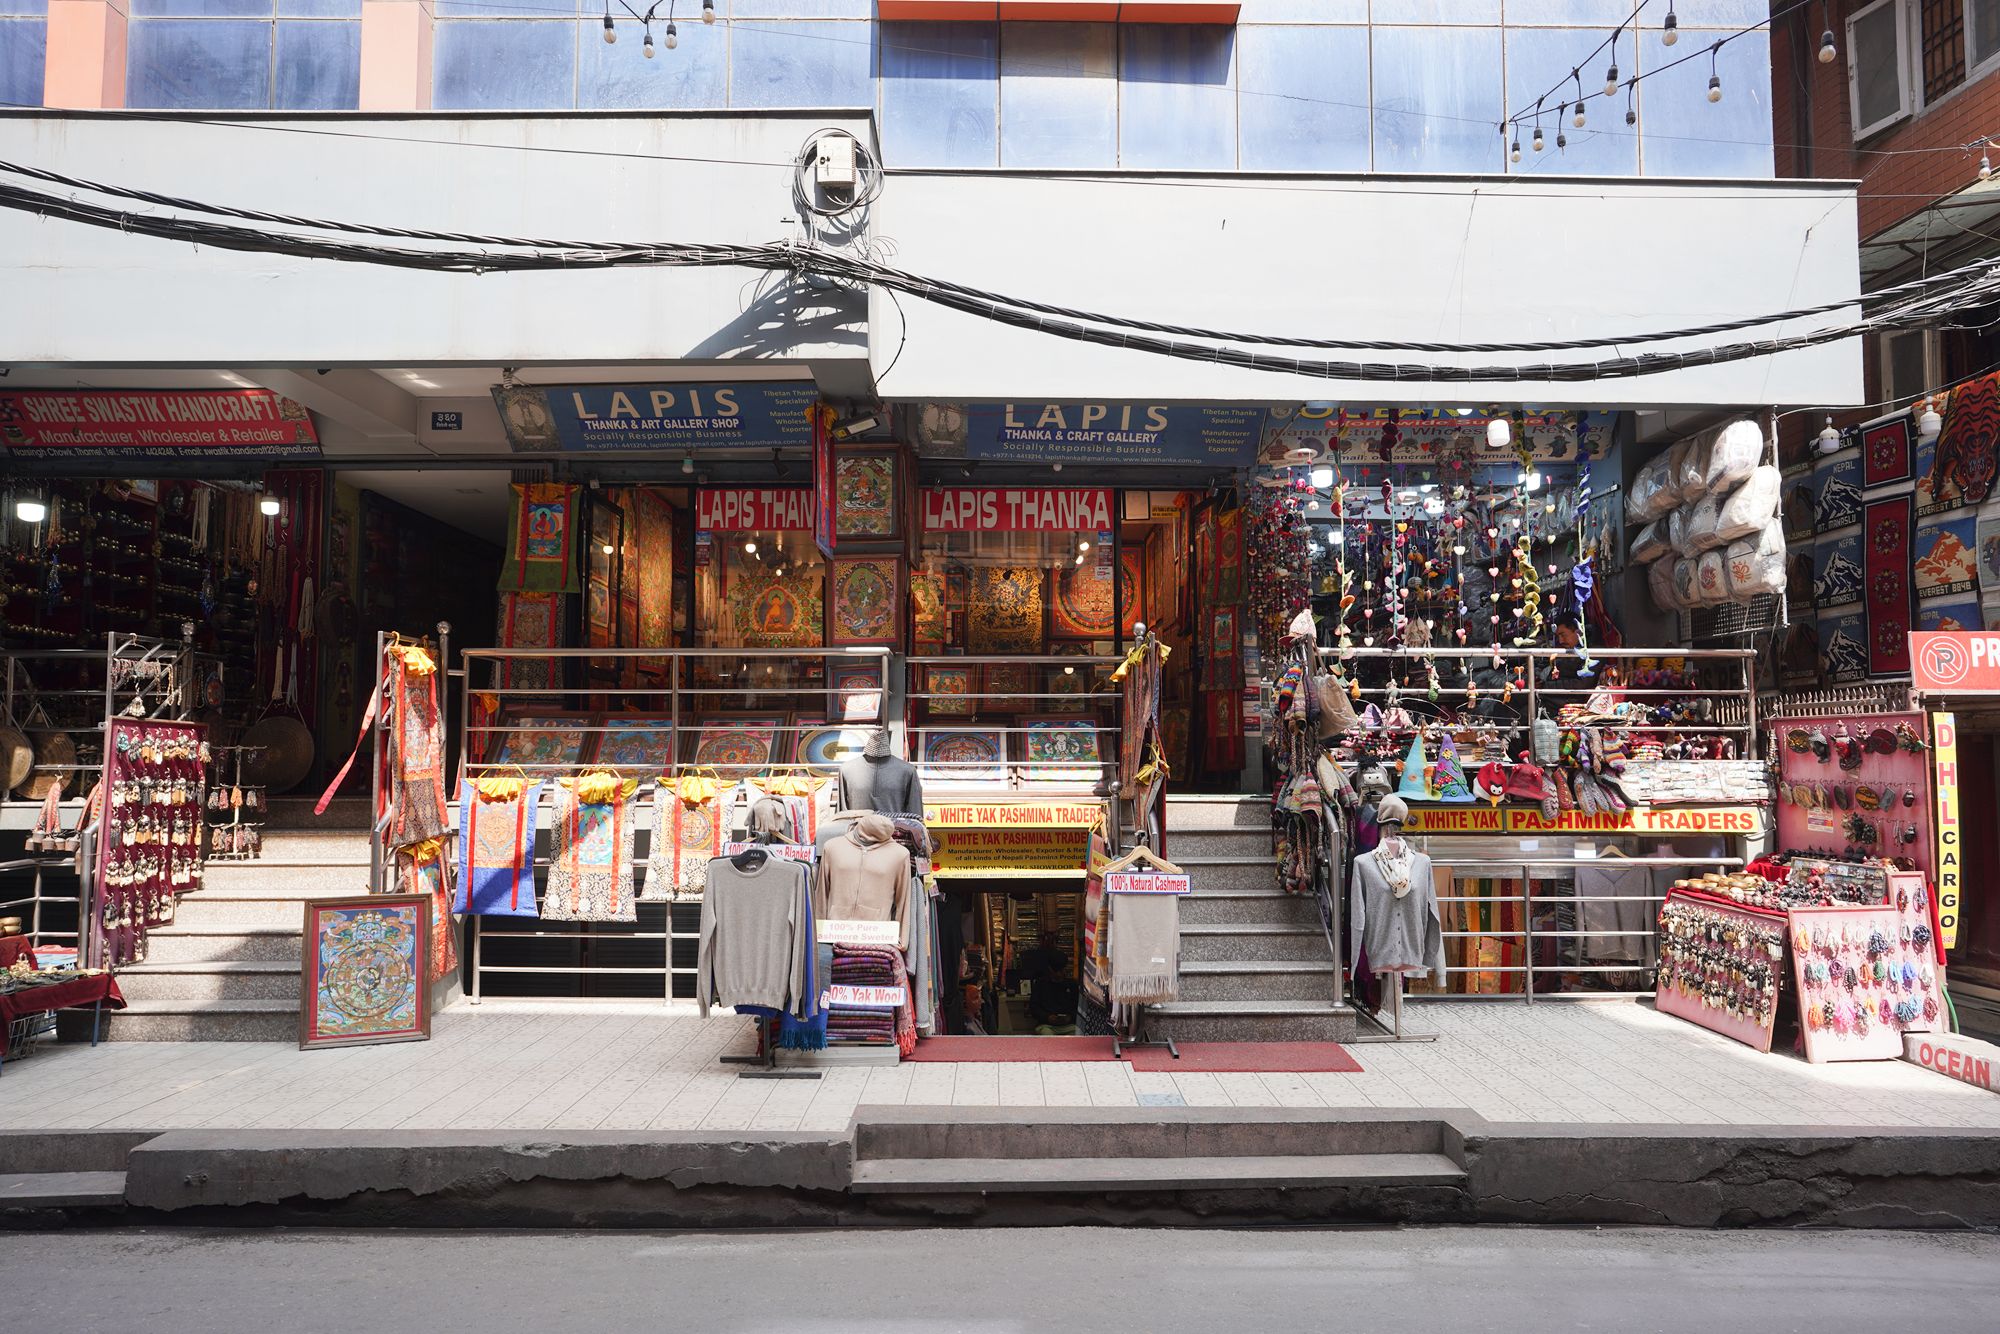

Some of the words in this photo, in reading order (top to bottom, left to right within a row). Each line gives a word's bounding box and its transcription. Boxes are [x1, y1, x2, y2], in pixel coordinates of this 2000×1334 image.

[22, 397, 87, 423] SHREE
[84, 396, 166, 423] SWASTIK
[163, 395, 274, 422] HANDICRAFT
[572, 389, 740, 419] LAPIS
[585, 420, 628, 430] THANKA
[631, 420, 638, 430] &
[641, 419, 660, 430] ART
[663, 419, 709, 429] GALLERY
[712, 418, 739, 428] SHOP
[1005, 404, 1168, 431] LAPIS
[1211, 417, 1245, 425] Specialist
[138, 429, 214, 443] Wholesaler
[218, 429, 230, 442] &
[231, 427, 284, 442] Retailer
[584, 432, 625, 441] Socially
[629, 431, 692, 441] Responsible
[697, 430, 742, 439] Business
[1005, 429, 1052, 440] THANKA
[1055, 430, 1063, 441] &
[1067, 431, 1104, 442] CRAFT
[1107, 432, 1158, 443] GALLERY
[1003, 442, 1044, 451] Socially
[1049, 443, 1112, 454] Responsible
[1116, 446, 1162, 454] Business
[1833, 460, 1855, 474] NEPAL
[699, 490, 755, 529] LAPIS
[761, 490, 813, 529] THAN
[925, 491, 998, 529] LAPIS
[1006, 491, 1111, 529] THANKA
[1918, 501, 1949, 516] EVEREST
[1918, 527, 1940, 539] NEPAL
[1838, 537, 1856, 549] NEPAL
[1919, 584, 1950, 598] EVEREST
[1819, 597, 1830, 607] MT.
[1831, 592, 1857, 606] MANASLU
[1840, 616, 1859, 628] NEPAL
[1920, 610, 1940, 622] NEPAL
[1937, 724, 1956, 825] DHL
[940, 807, 973, 823] WHITE
[976, 807, 997, 823] YAK
[1000, 807, 1052, 823] PASHMINA
[1423, 811, 1468, 829] WHITE
[1471, 811, 1499, 829] YAK
[1642, 812, 1754, 830] TRADERS
[947, 832, 980, 845] WHITE
[981, 832, 1001, 845] YAK
[1003, 831, 1055, 845] PASHMINA
[1056, 831, 1087, 844] TRADE
[785, 846, 811, 861] Blanket
[1111, 875, 1128, 891] 100%
[1130, 875, 1153, 891] Natural
[1155, 875, 1187, 891] Cashmere
[1940, 831, 1957, 928] CARGO
[830, 923, 854, 931] 100%
[857, 923, 879, 931] Pure
[862, 933, 895, 941] Sweter
[852, 987, 871, 1003] Yak
[874, 988, 901, 1003] Wool
[1920, 1042, 1991, 1089] OCEAN
